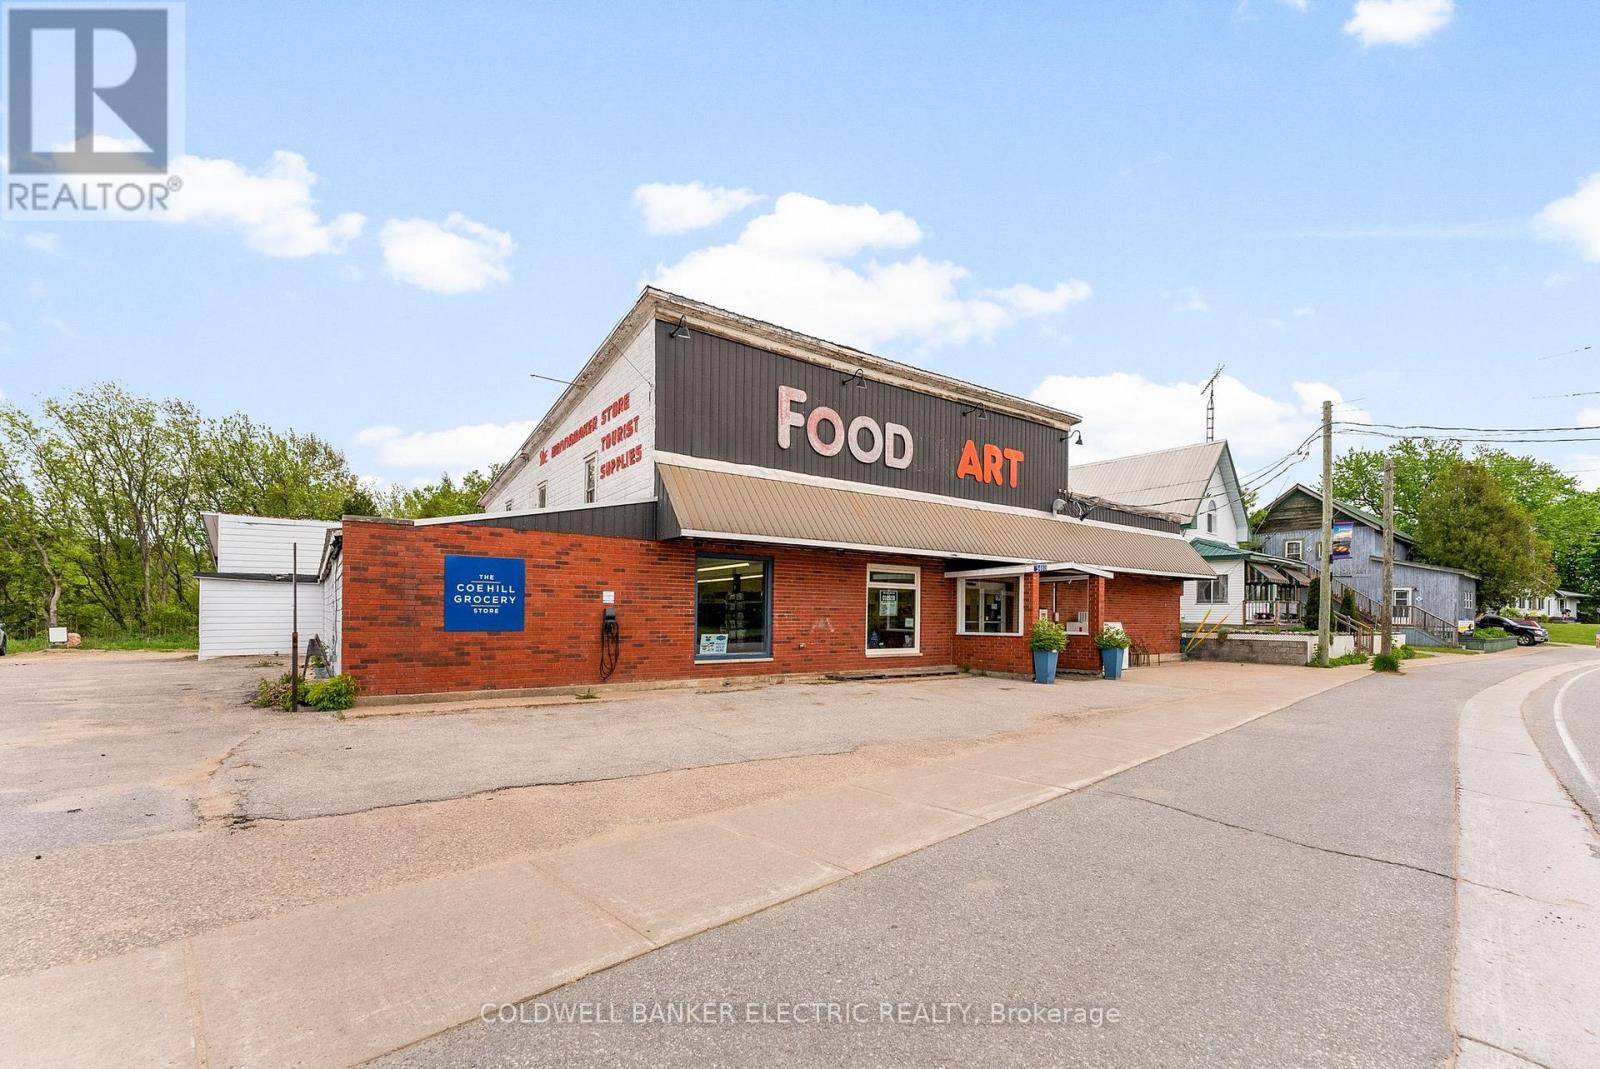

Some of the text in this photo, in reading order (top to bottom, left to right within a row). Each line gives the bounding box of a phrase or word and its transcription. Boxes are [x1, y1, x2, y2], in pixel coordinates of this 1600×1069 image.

[601, 391, 631, 426] STORE
[601, 415, 640, 452] TOURIST
[777, 384, 914, 471] FOOD
[600, 444, 643, 480] SUPPLIES
[956, 439, 1025, 489] ART
[454, 595, 517, 604] GROCERY
[456, 584, 516, 593] COE HILL
